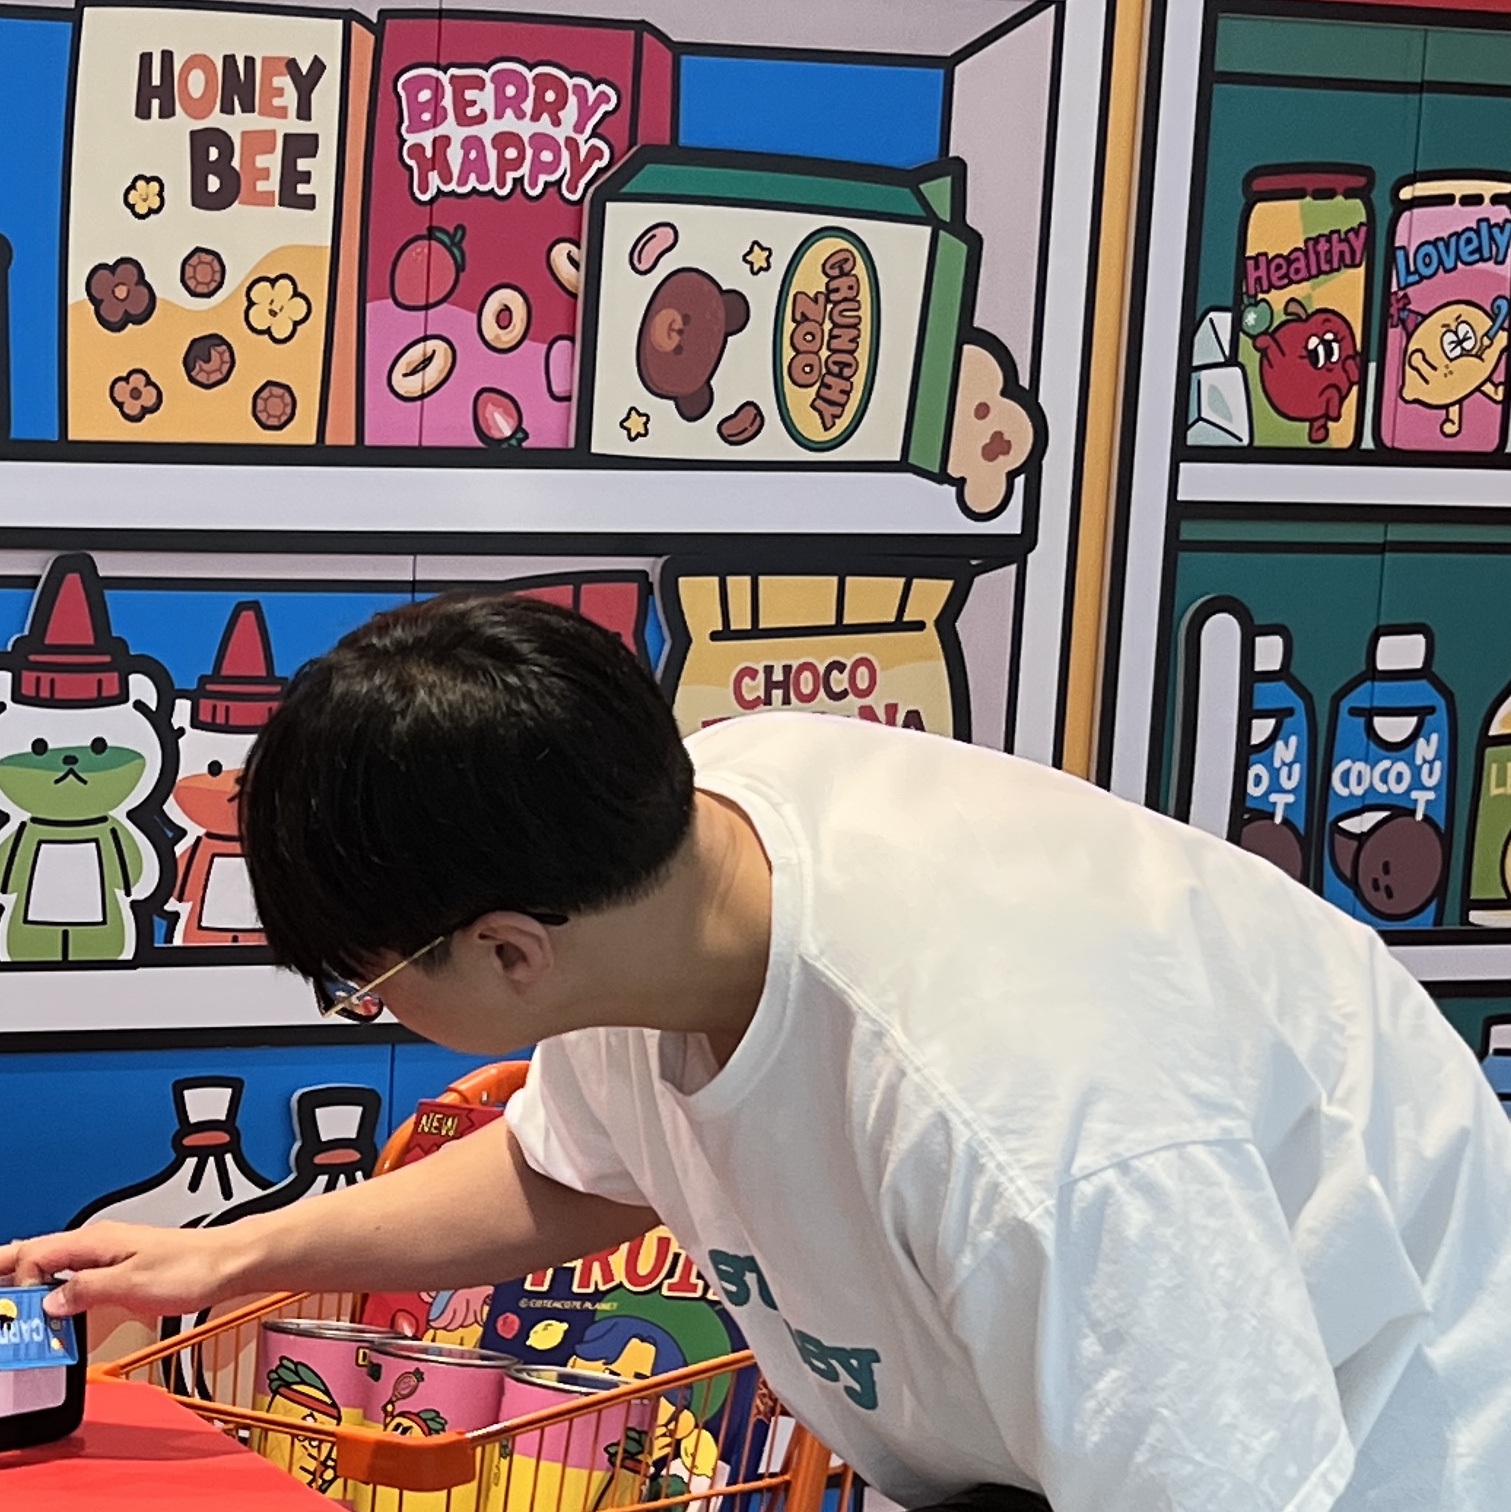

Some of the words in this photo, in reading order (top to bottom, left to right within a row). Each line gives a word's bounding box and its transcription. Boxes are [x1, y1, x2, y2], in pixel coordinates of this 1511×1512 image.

[135, 51, 326, 122] HONEY
[395, 60, 619, 138] BERRY
[189, 129, 320, 211] BEE
[403, 130, 611, 199] HAPPY
[1245, 223, 1368, 294] Healthy
[1396, 219, 1511, 290] Lovely
[789, 289, 827, 389] ZOO
[818, 248, 857, 431] CRUNCHY
[733, 657, 876, 710] CHOCO
[418, 1112, 458, 1137] NEW
